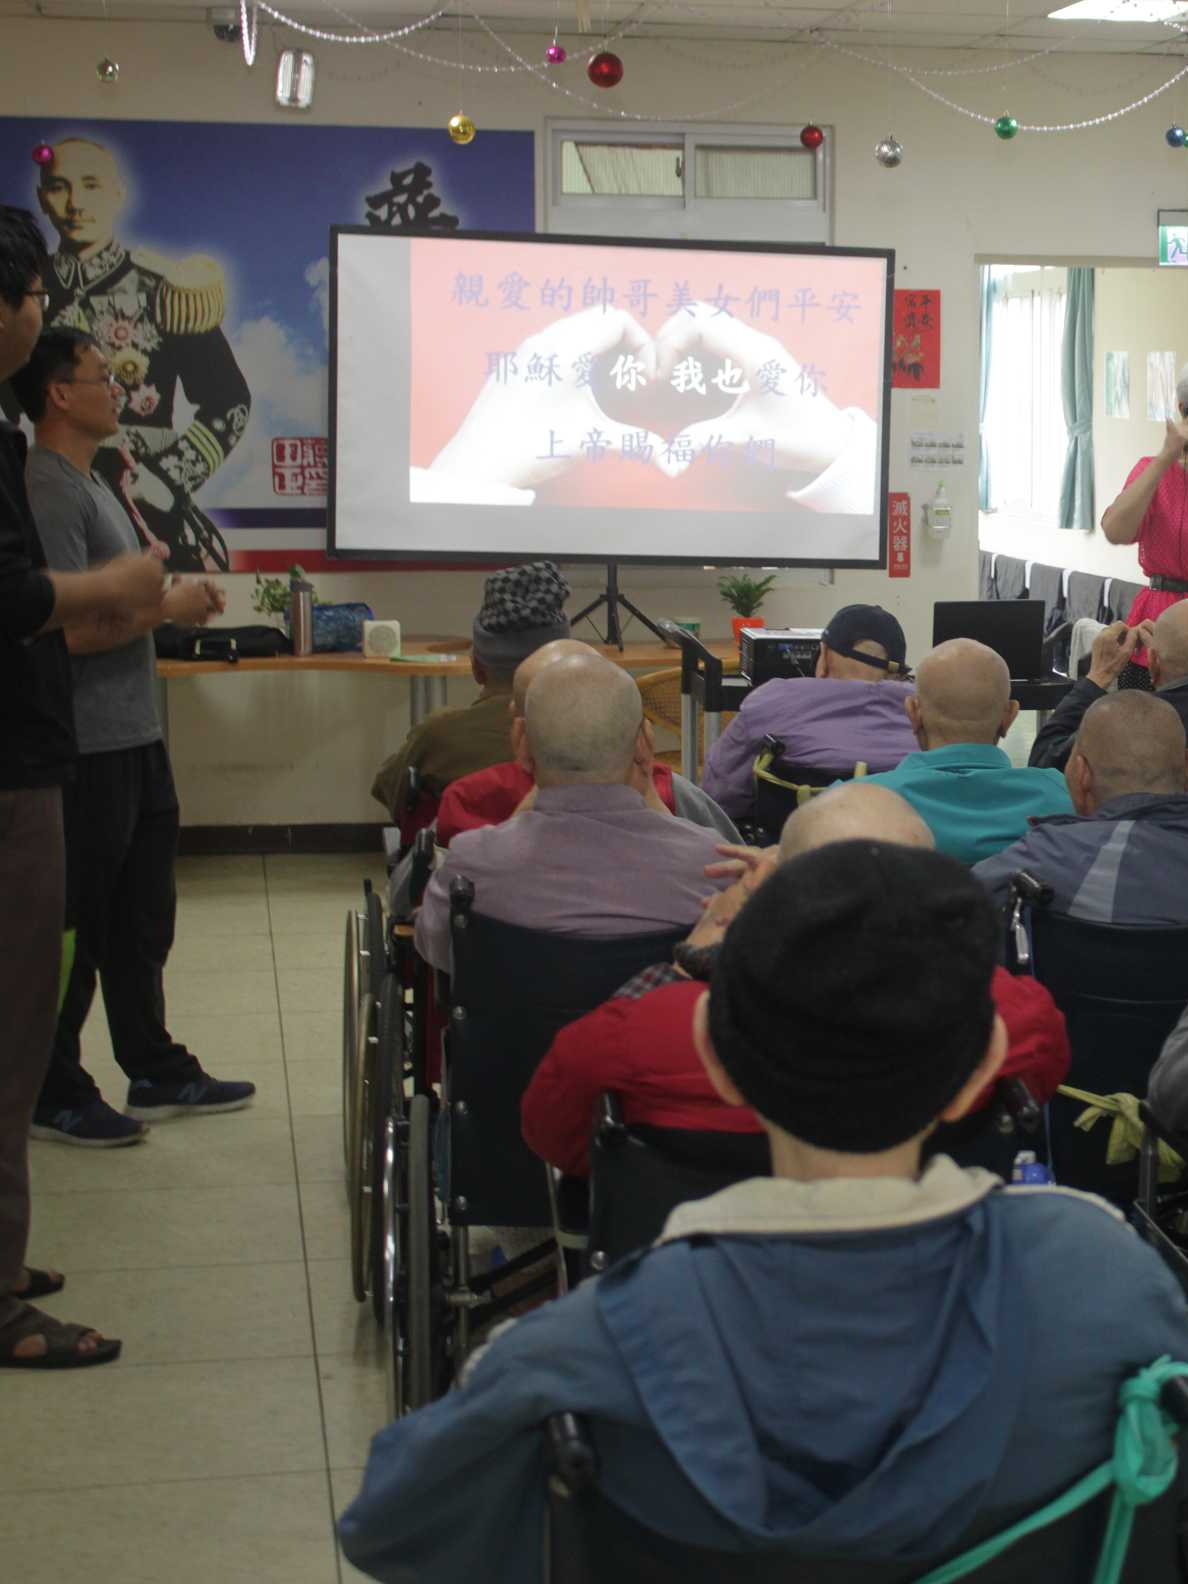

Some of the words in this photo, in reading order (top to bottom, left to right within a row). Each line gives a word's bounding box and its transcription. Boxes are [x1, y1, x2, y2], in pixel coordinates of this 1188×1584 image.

[451, 271, 863, 325] 親愛的帥哥美女們平安
[535, 427, 777, 472] 上帝賜福你們
[892, 500, 909, 551] 滅火器
